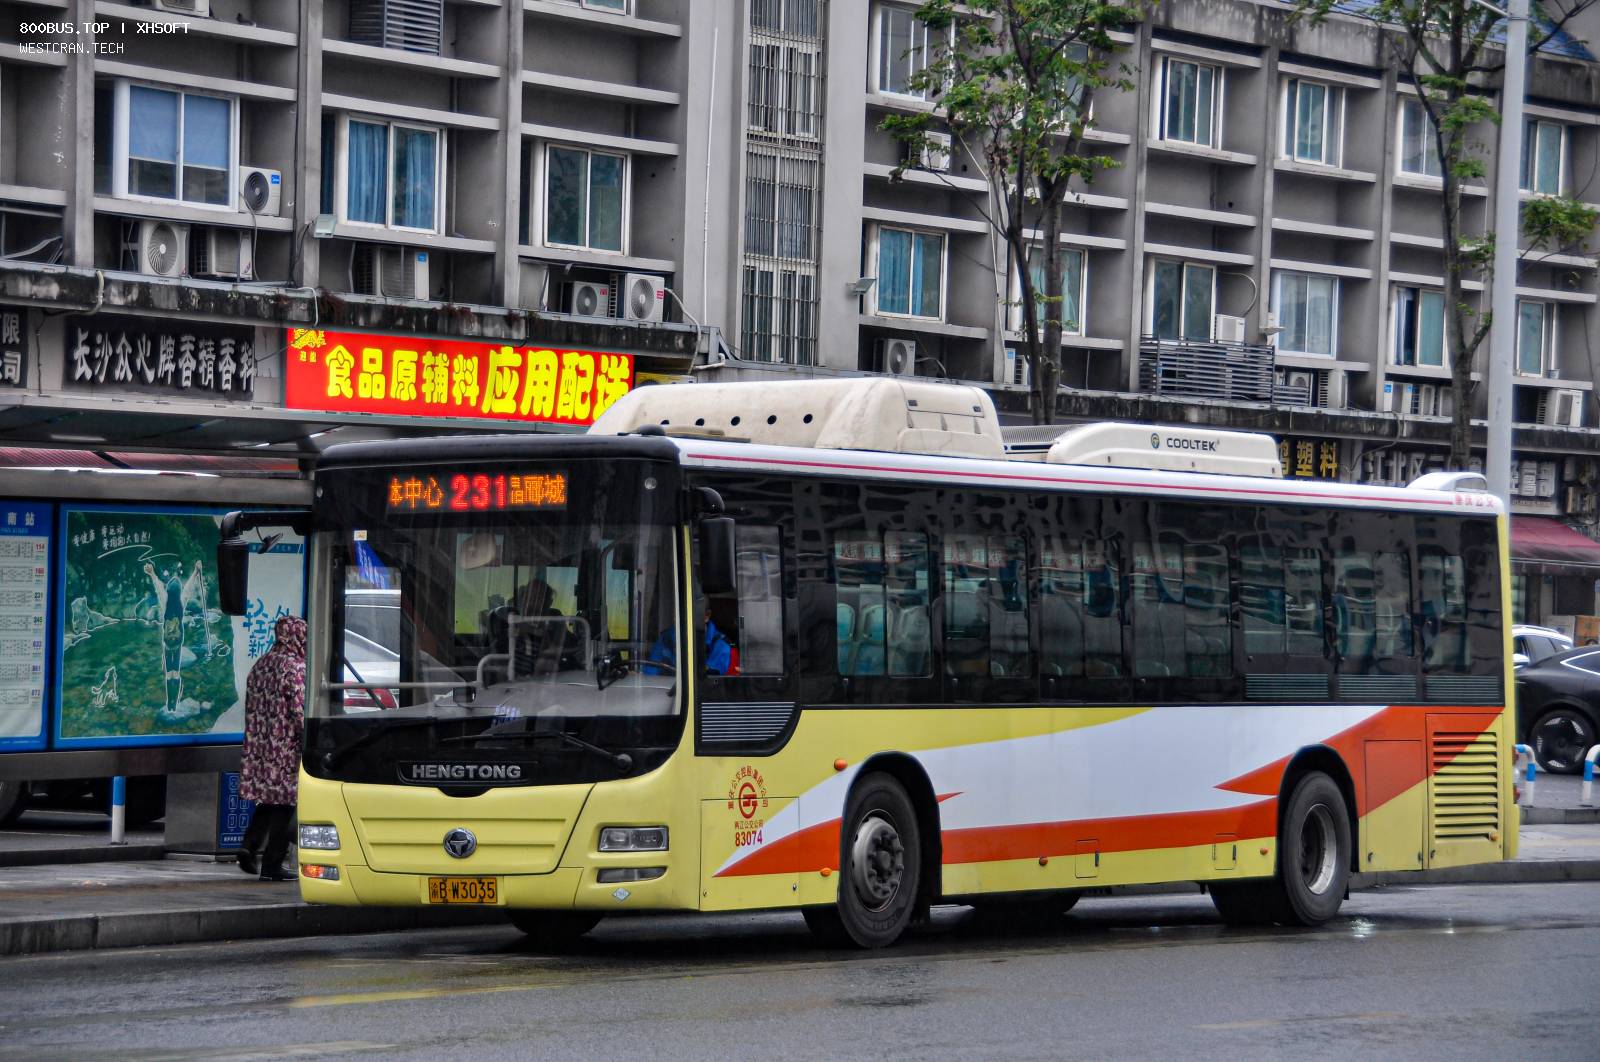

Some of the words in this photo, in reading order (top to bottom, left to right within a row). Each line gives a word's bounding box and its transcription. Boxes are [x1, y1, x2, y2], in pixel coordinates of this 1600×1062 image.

[0, 313, 20, 345] 限
[0, 351, 21, 384] 司
[325, 345, 629, 421] 食品原辅料应用配送
[1167, 438, 1216, 451] COOLTEK
[450, 474, 506, 511] 231
[412, 764, 521, 779] HENGTONG
[735, 830, 763, 847] 83074
